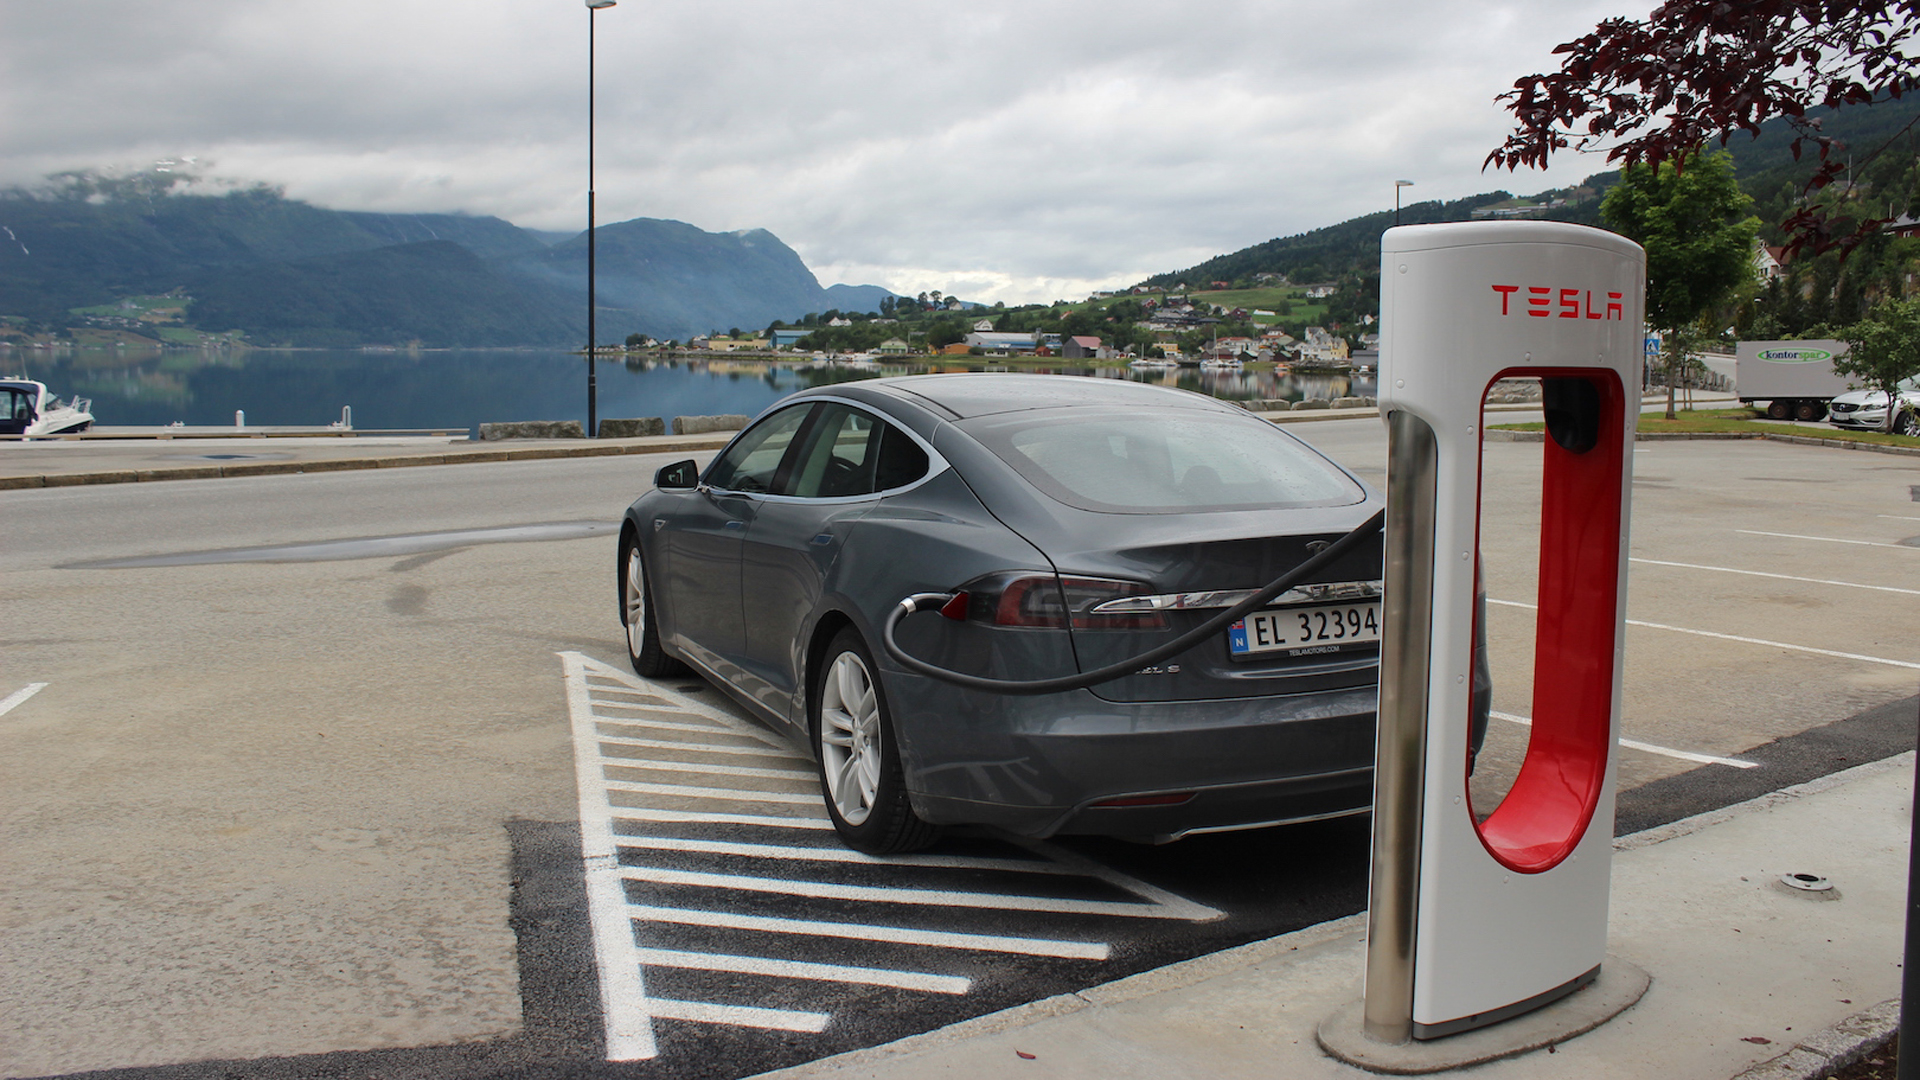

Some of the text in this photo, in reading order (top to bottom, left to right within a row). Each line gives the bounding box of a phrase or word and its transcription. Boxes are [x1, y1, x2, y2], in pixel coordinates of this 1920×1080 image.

[1491, 285, 1623, 321] TESLA
[1766, 350, 1821, 361] kontorspar
[1255, 607, 1378, 646] EL 32394
[1235, 638, 1244, 647] N
